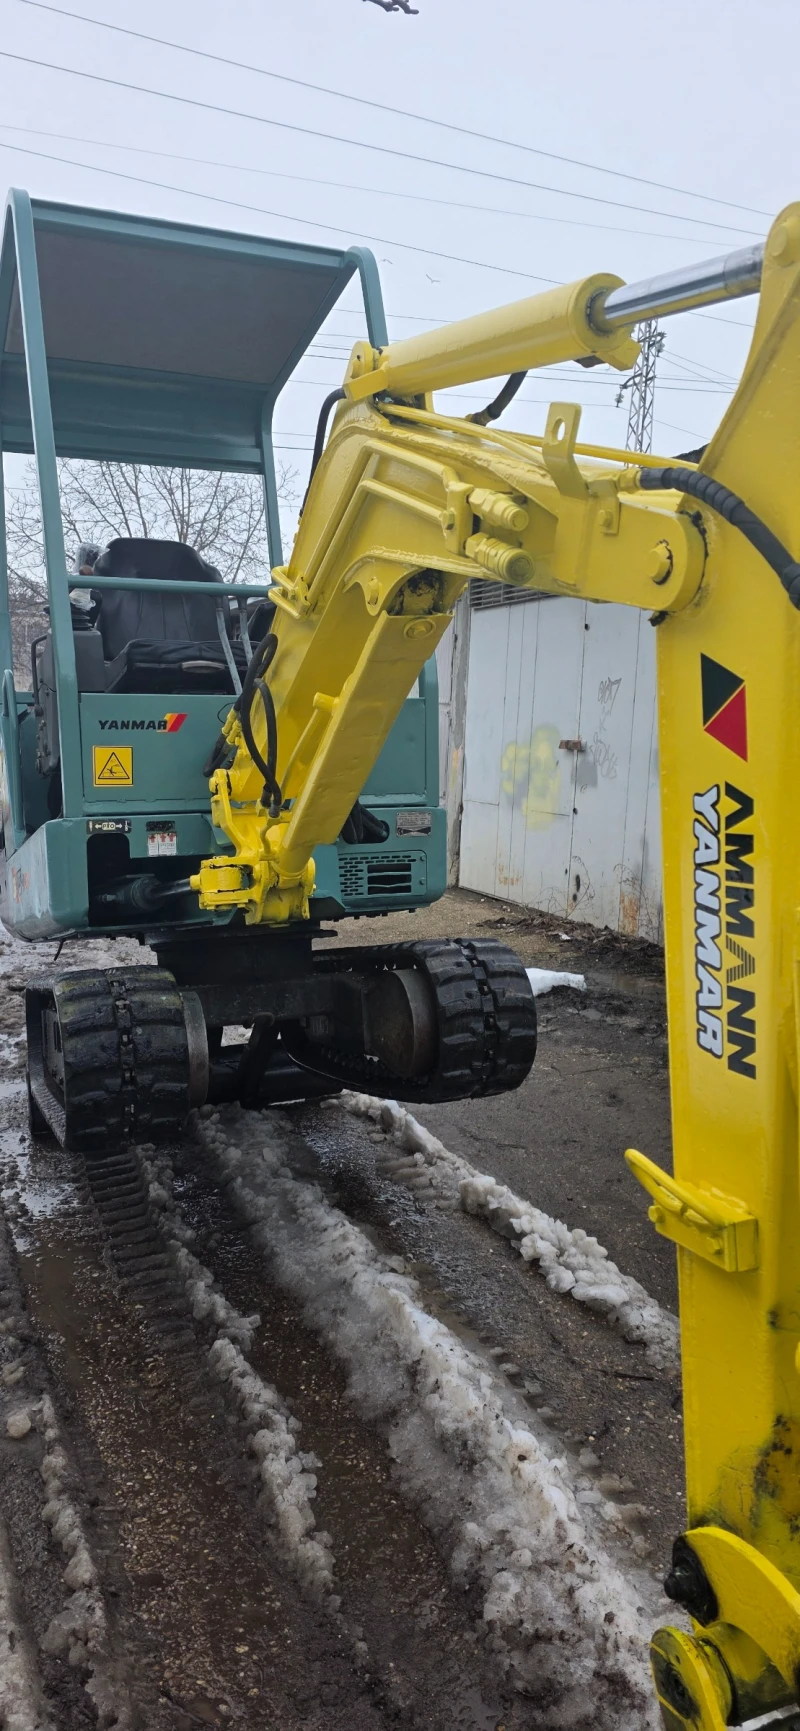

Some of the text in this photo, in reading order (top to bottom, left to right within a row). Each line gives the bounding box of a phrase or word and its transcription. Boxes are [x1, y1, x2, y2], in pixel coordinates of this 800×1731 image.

[98, 720, 168, 730] YANMAR
[693, 784, 723, 1060] YANMAR
[724, 780, 757, 1080] AMMANN
